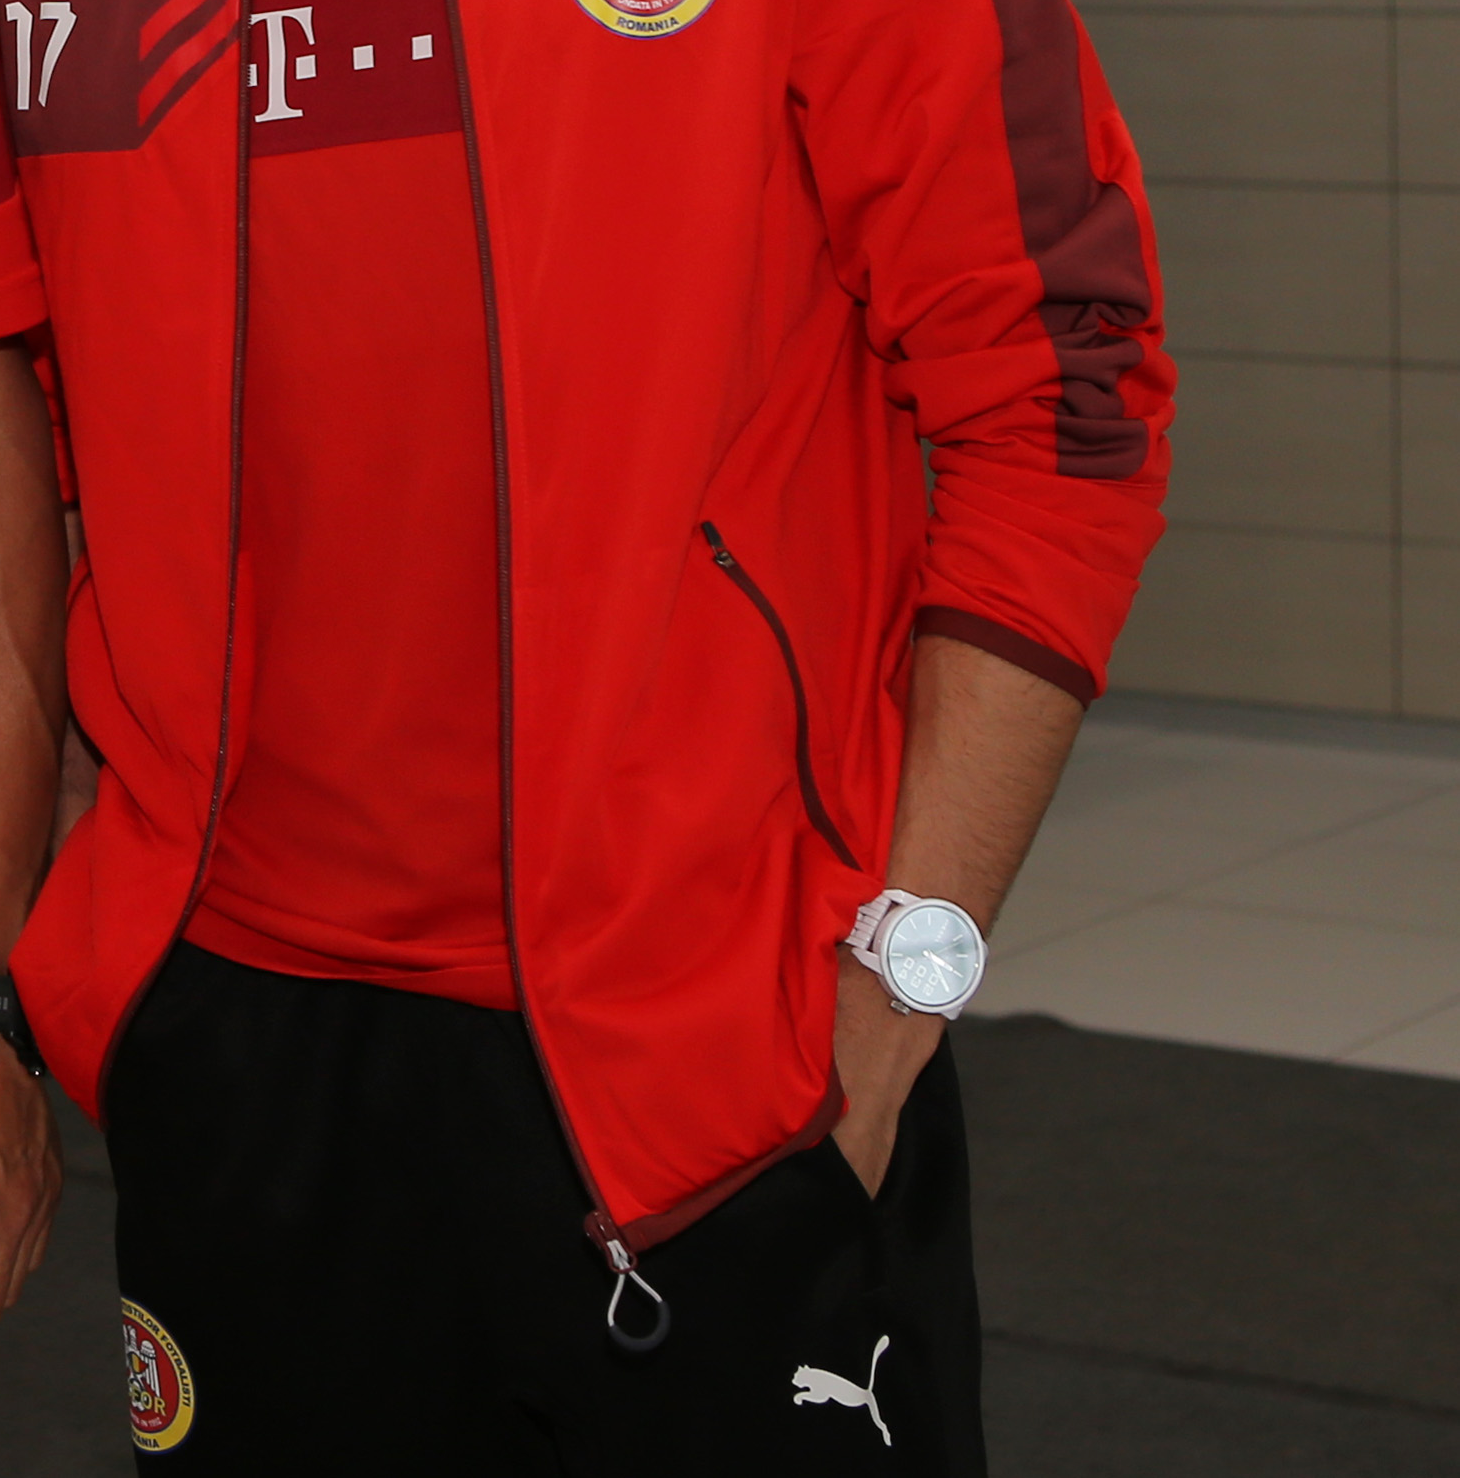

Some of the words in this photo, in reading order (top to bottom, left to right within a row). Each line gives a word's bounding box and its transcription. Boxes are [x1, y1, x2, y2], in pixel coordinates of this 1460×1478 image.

[5, 2, 77, 111] 17
[616, 16, 679, 33] ROMANIA
[161, 1334, 191, 1407] FOTBALISTI
